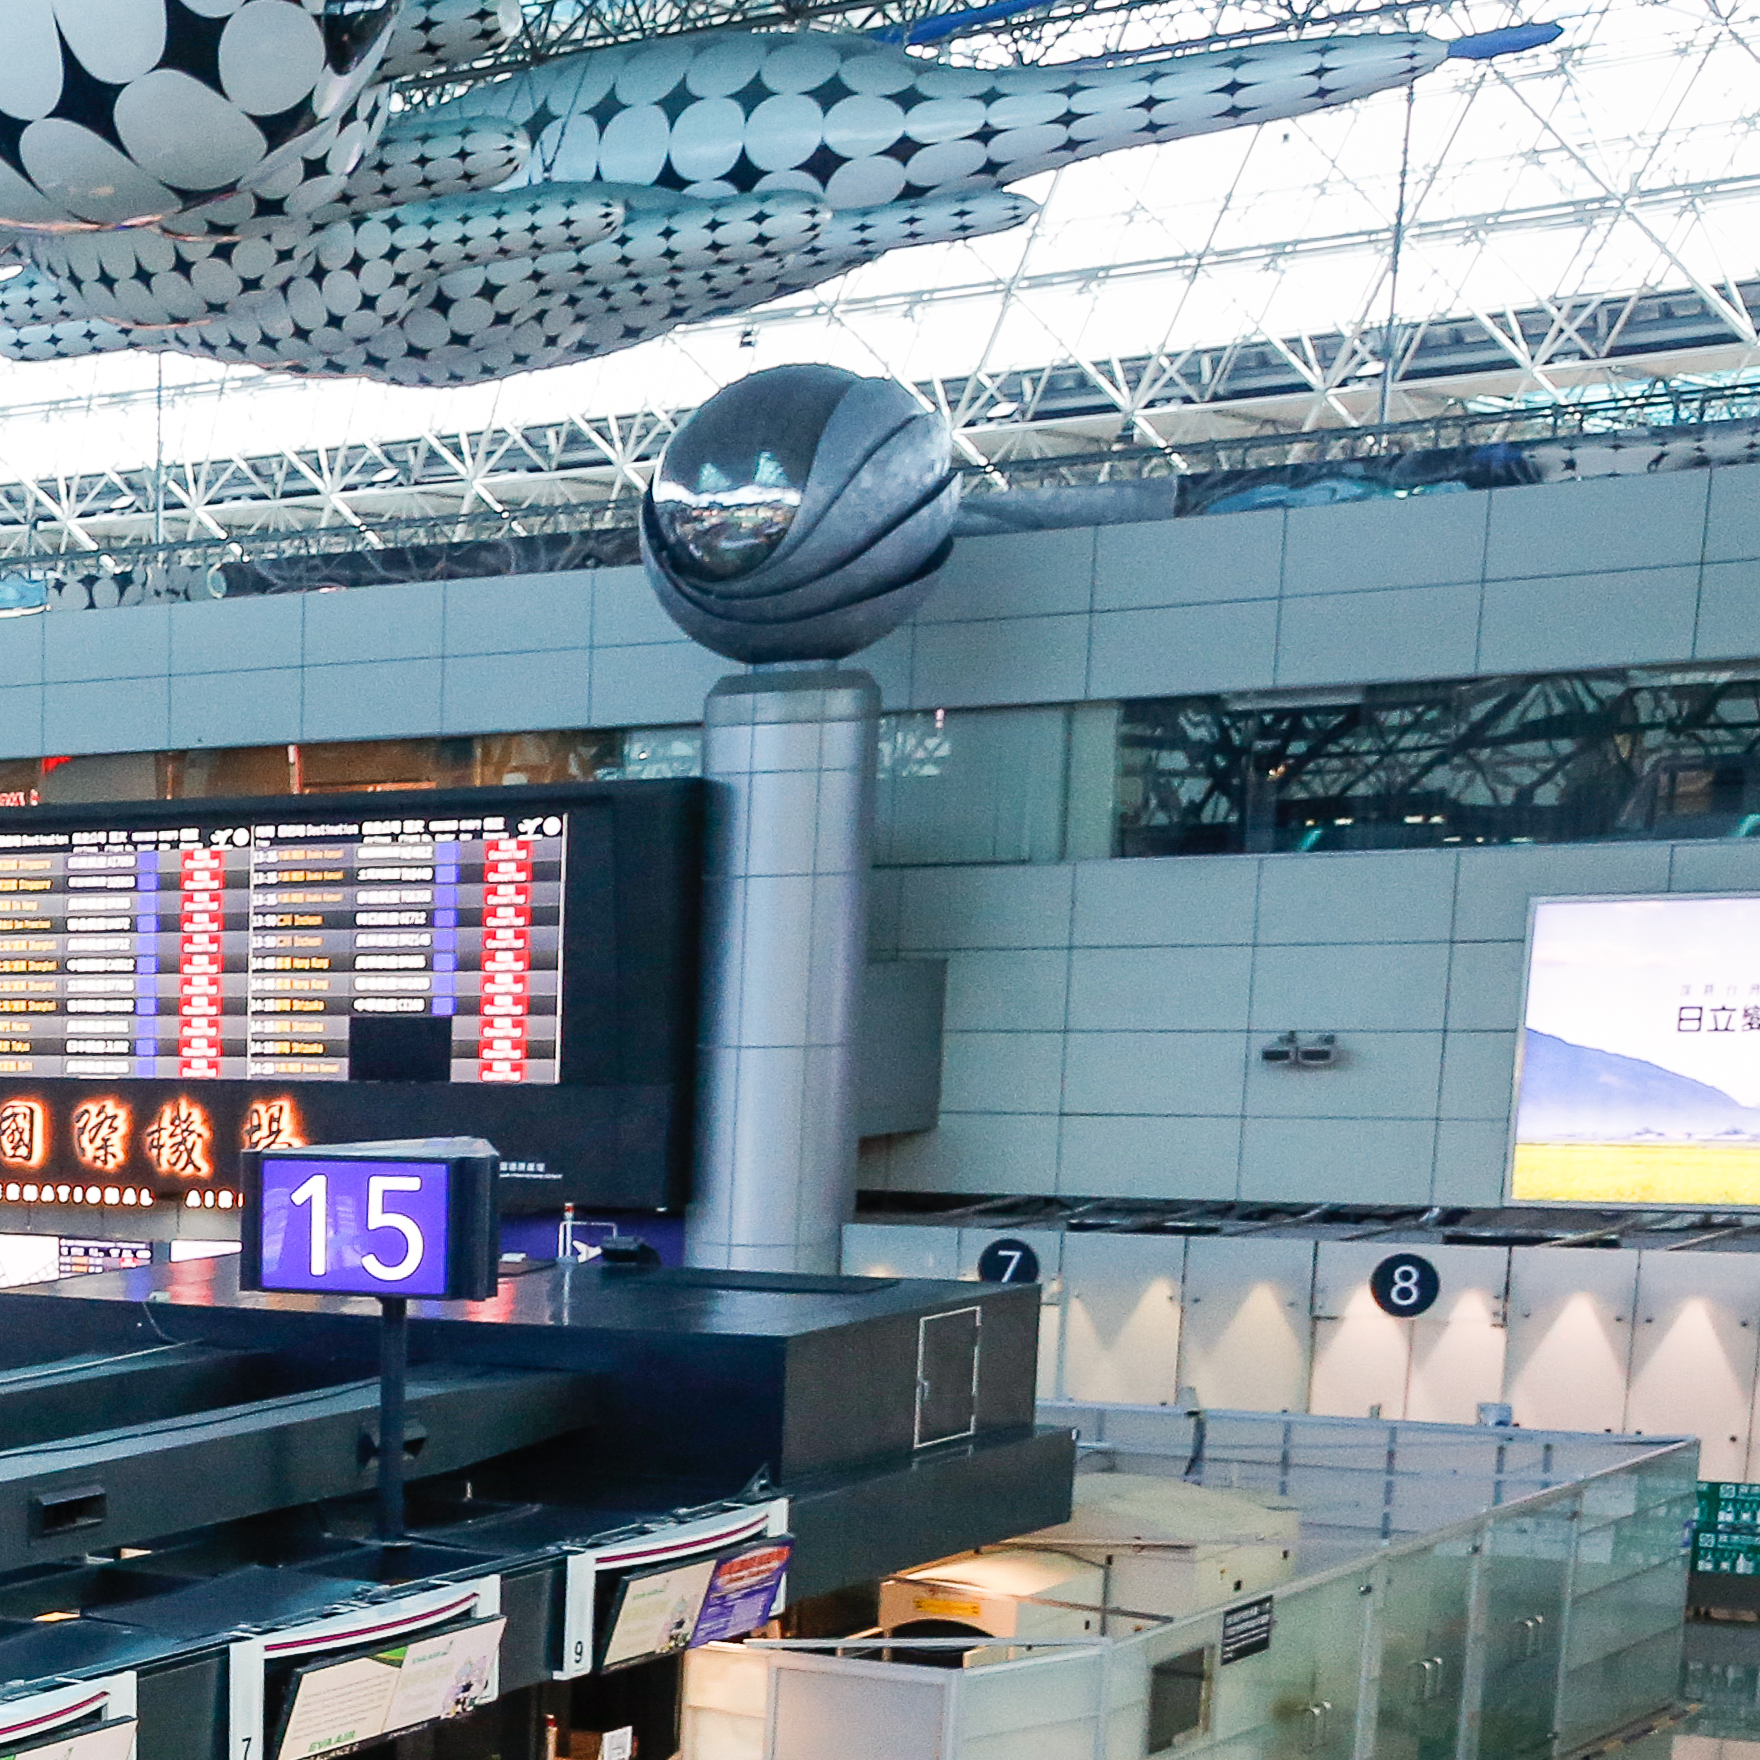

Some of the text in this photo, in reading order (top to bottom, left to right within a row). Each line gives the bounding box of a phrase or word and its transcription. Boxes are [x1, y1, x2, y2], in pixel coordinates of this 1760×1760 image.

[290, 1174, 426, 1282] 15
[999, 1251, 1021, 1285] 7
[1392, 1265, 1419, 1307] 8
[574, 1640, 583, 1663] 9
